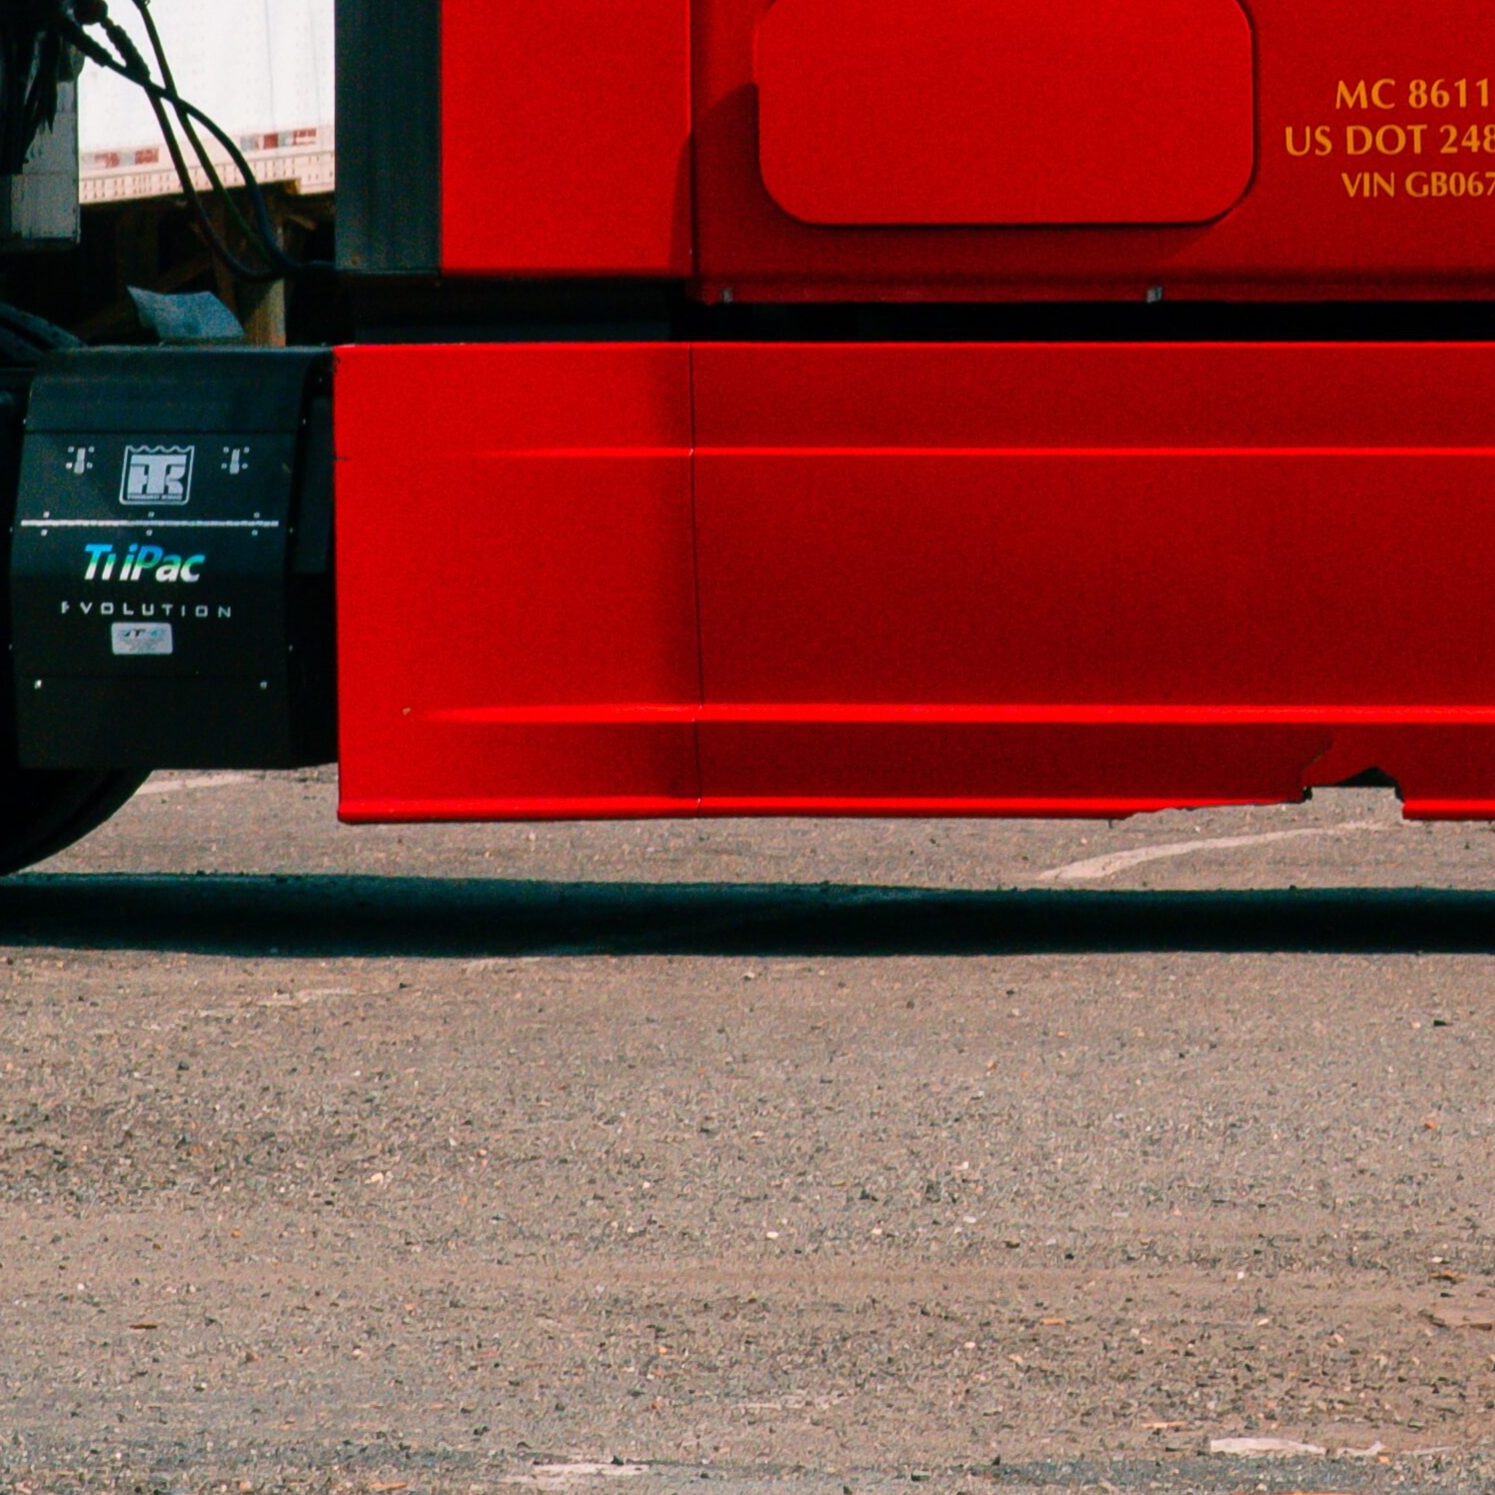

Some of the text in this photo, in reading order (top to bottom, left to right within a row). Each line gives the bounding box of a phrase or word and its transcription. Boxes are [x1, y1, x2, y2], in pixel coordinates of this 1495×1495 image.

[1336, 80, 1395, 109] MC
[1285, 126, 1332, 156] US
[1346, 124, 1427, 155] DOT
[1342, 172, 1395, 198] VIN
